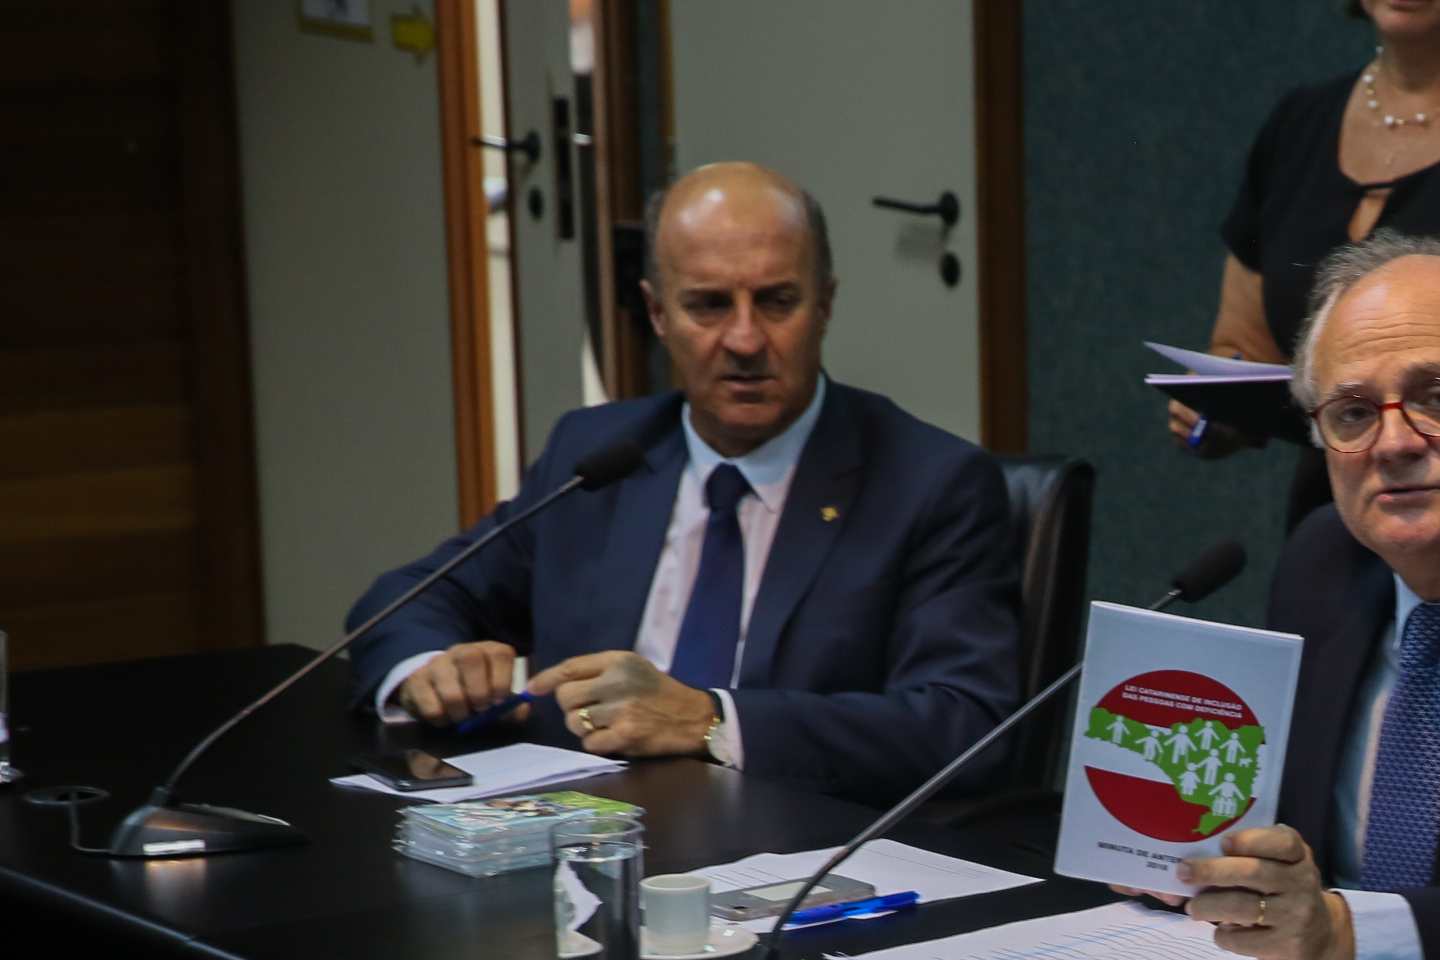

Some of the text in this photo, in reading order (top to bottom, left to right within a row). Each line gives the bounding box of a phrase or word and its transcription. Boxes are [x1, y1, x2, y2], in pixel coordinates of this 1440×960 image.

[1122, 692, 1138, 700] DAS
[1139, 695, 1175, 707] PESSOAS
[1176, 702, 1194, 710] COM
[1138, 687, 1190, 701] CATARINENSE
[1097, 841, 1134, 854] MINUTA
[1136, 849, 1149, 857] DE
